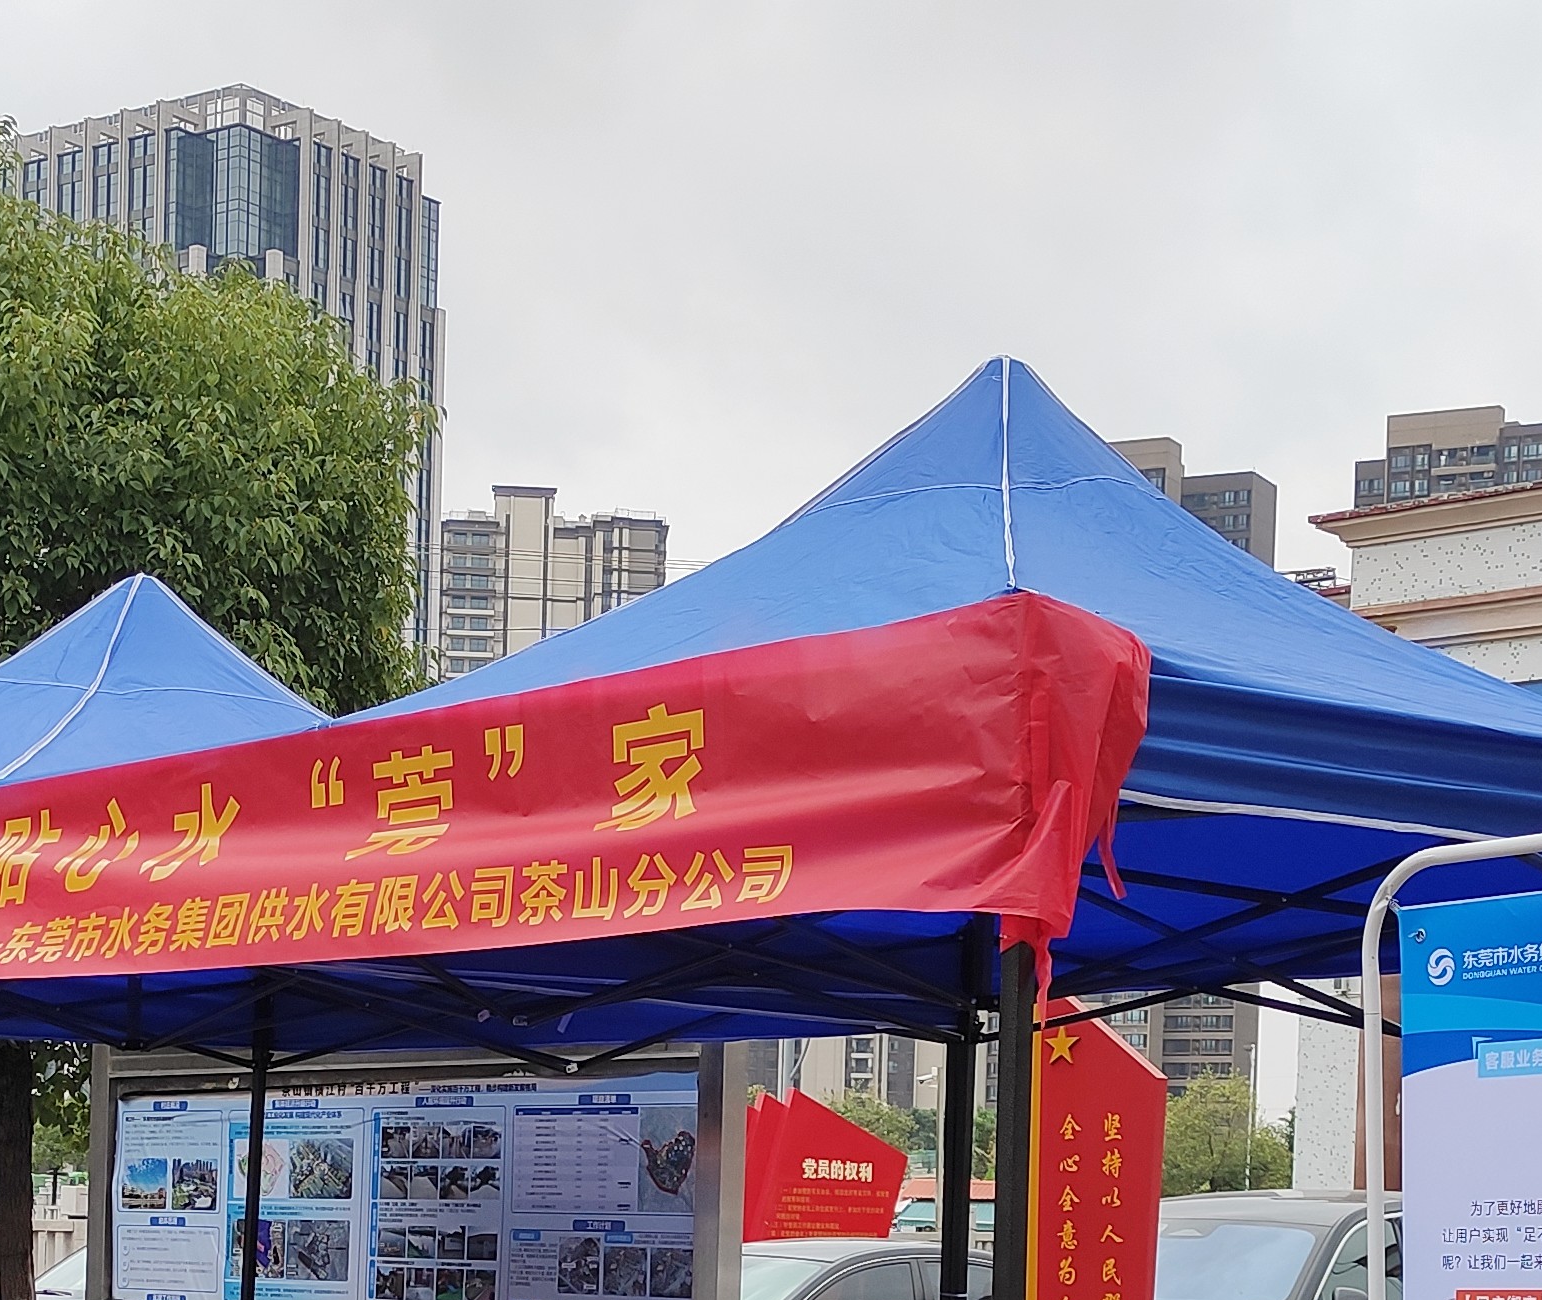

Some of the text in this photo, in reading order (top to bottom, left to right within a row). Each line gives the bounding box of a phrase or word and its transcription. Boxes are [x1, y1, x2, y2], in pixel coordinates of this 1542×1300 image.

[1462, 968, 1508, 980] DONGGUAN
[1509, 964, 1537, 976] WATER
[802, 1158, 873, 1183] 党员的权利
